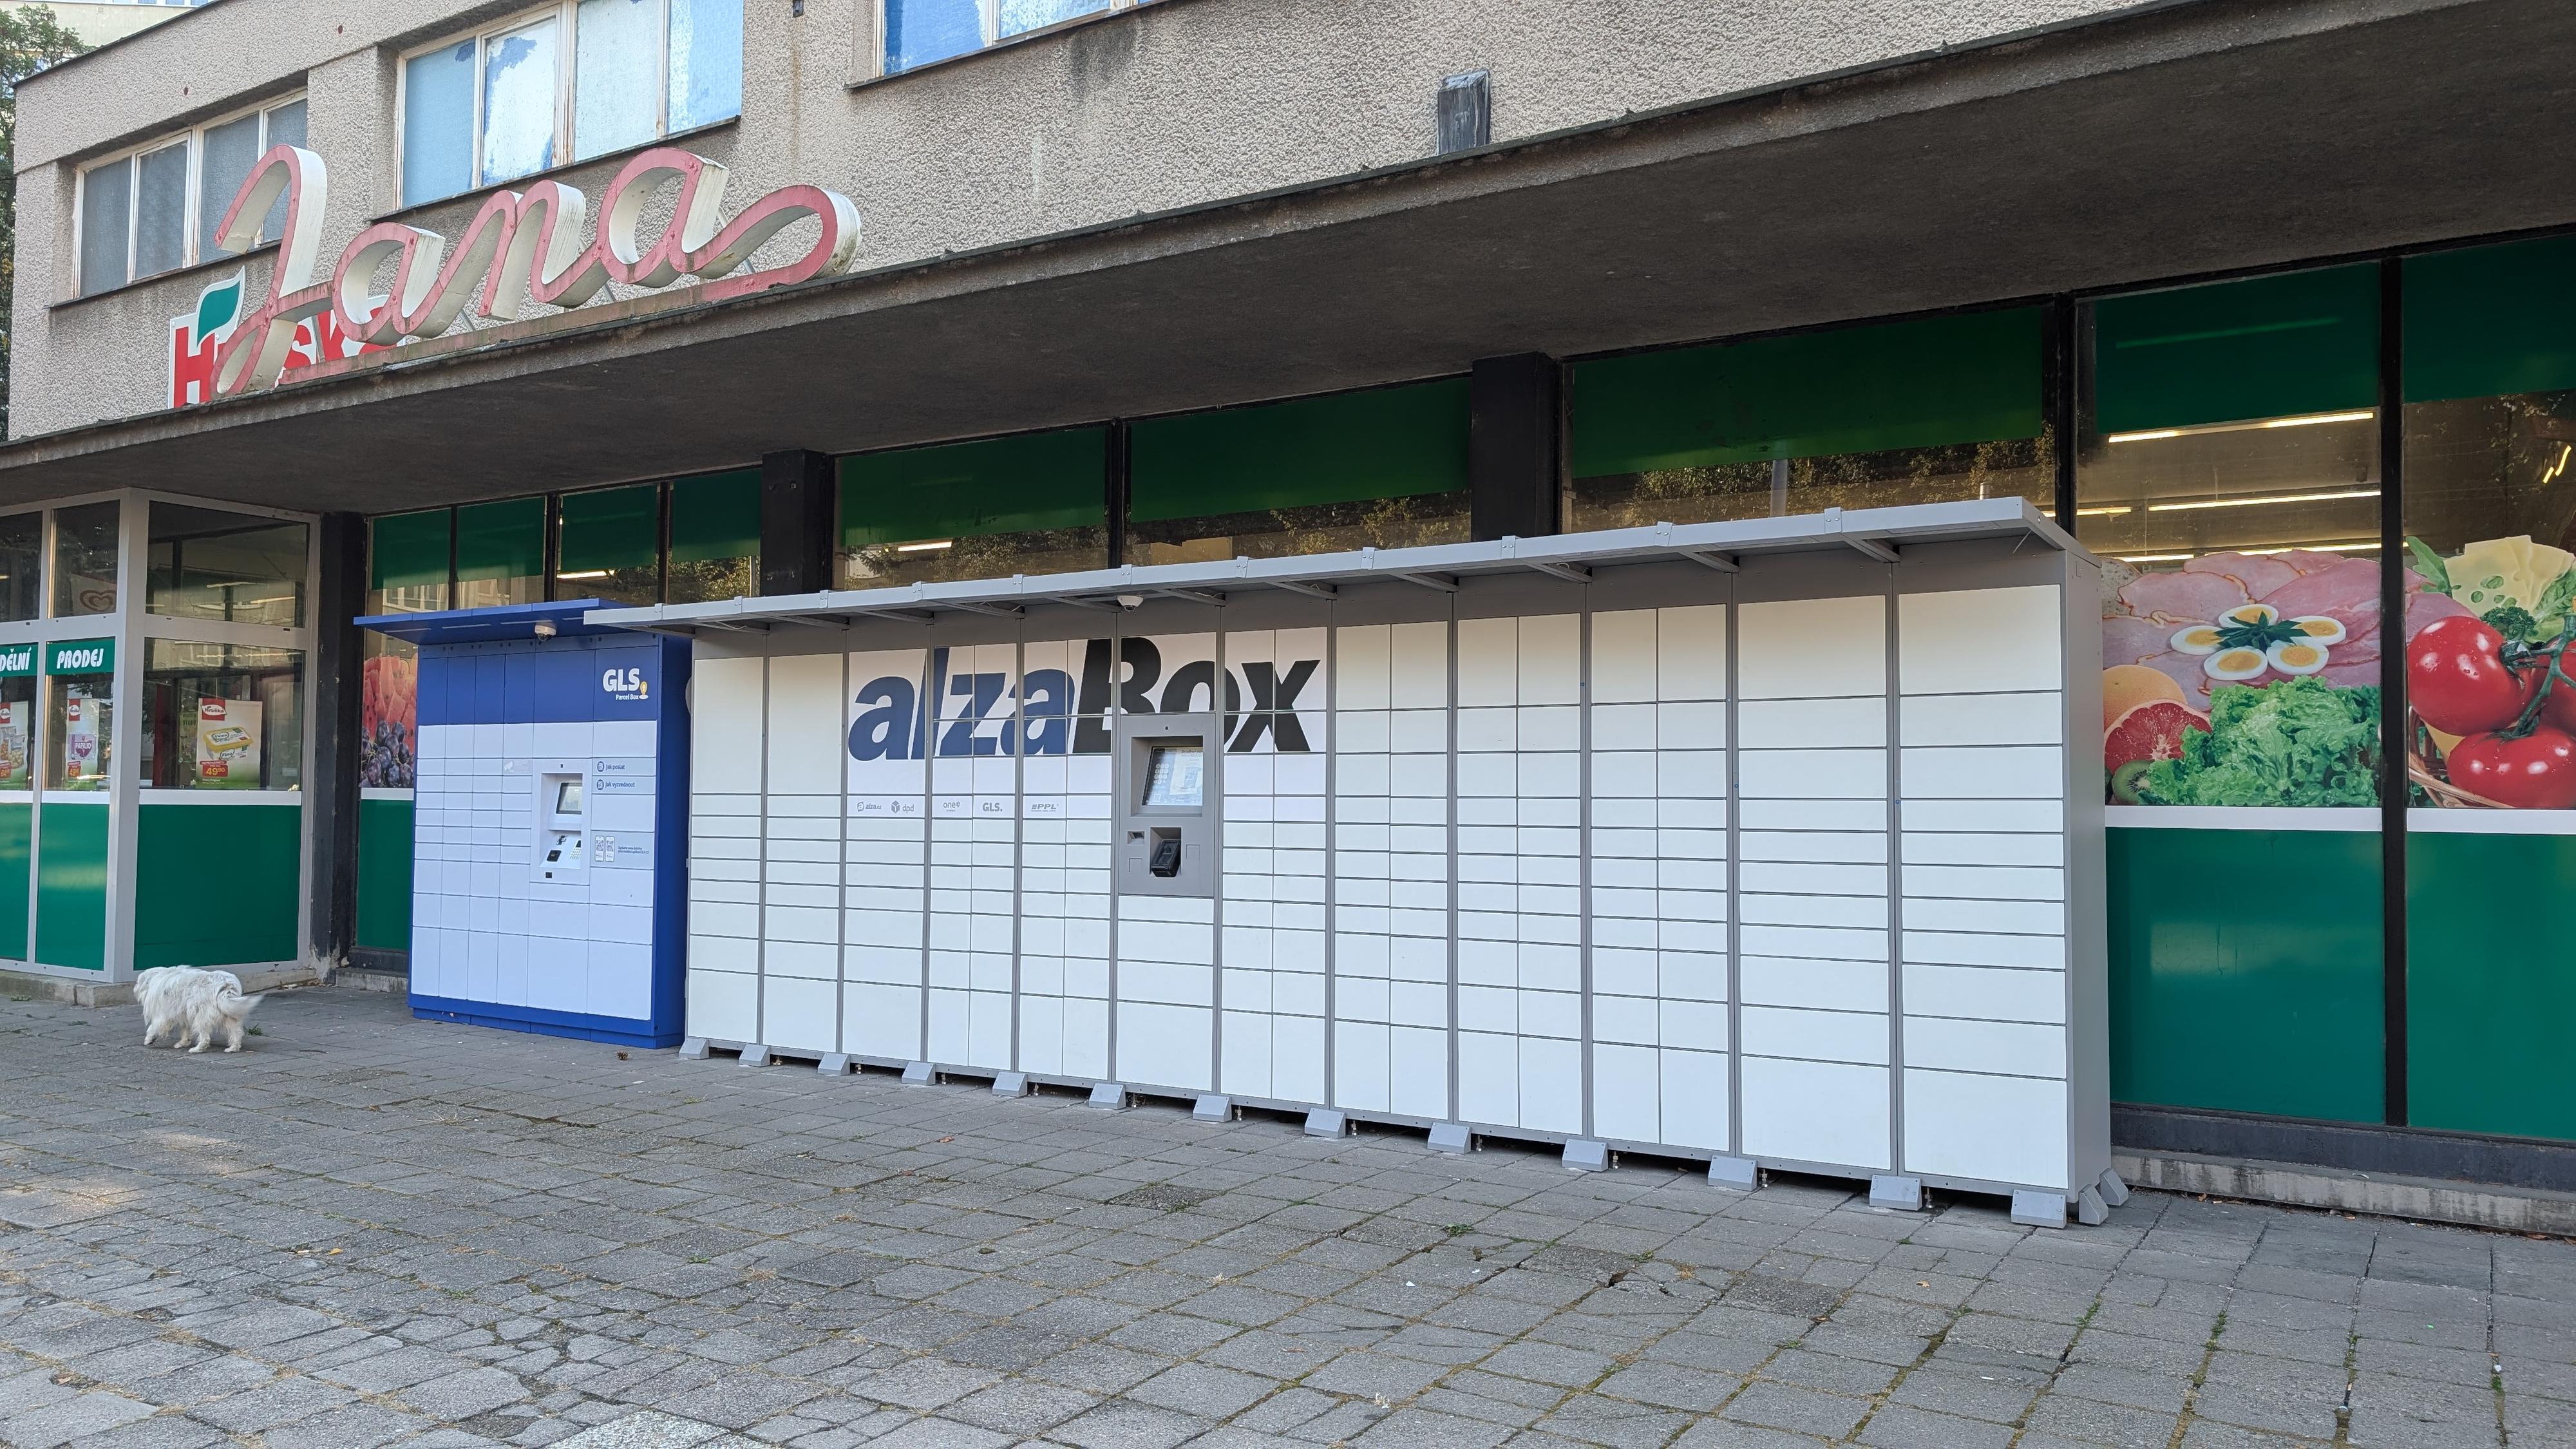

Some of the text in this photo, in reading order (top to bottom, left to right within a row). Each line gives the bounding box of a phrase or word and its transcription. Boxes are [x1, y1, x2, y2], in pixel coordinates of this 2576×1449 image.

[211, 144, 862, 397] Jana
[57, 649, 104, 669] PRODEJ
[603, 668, 640, 692] GLS
[848, 637, 1321, 761] alzaBox
[902, 804, 914, 813] dpd
